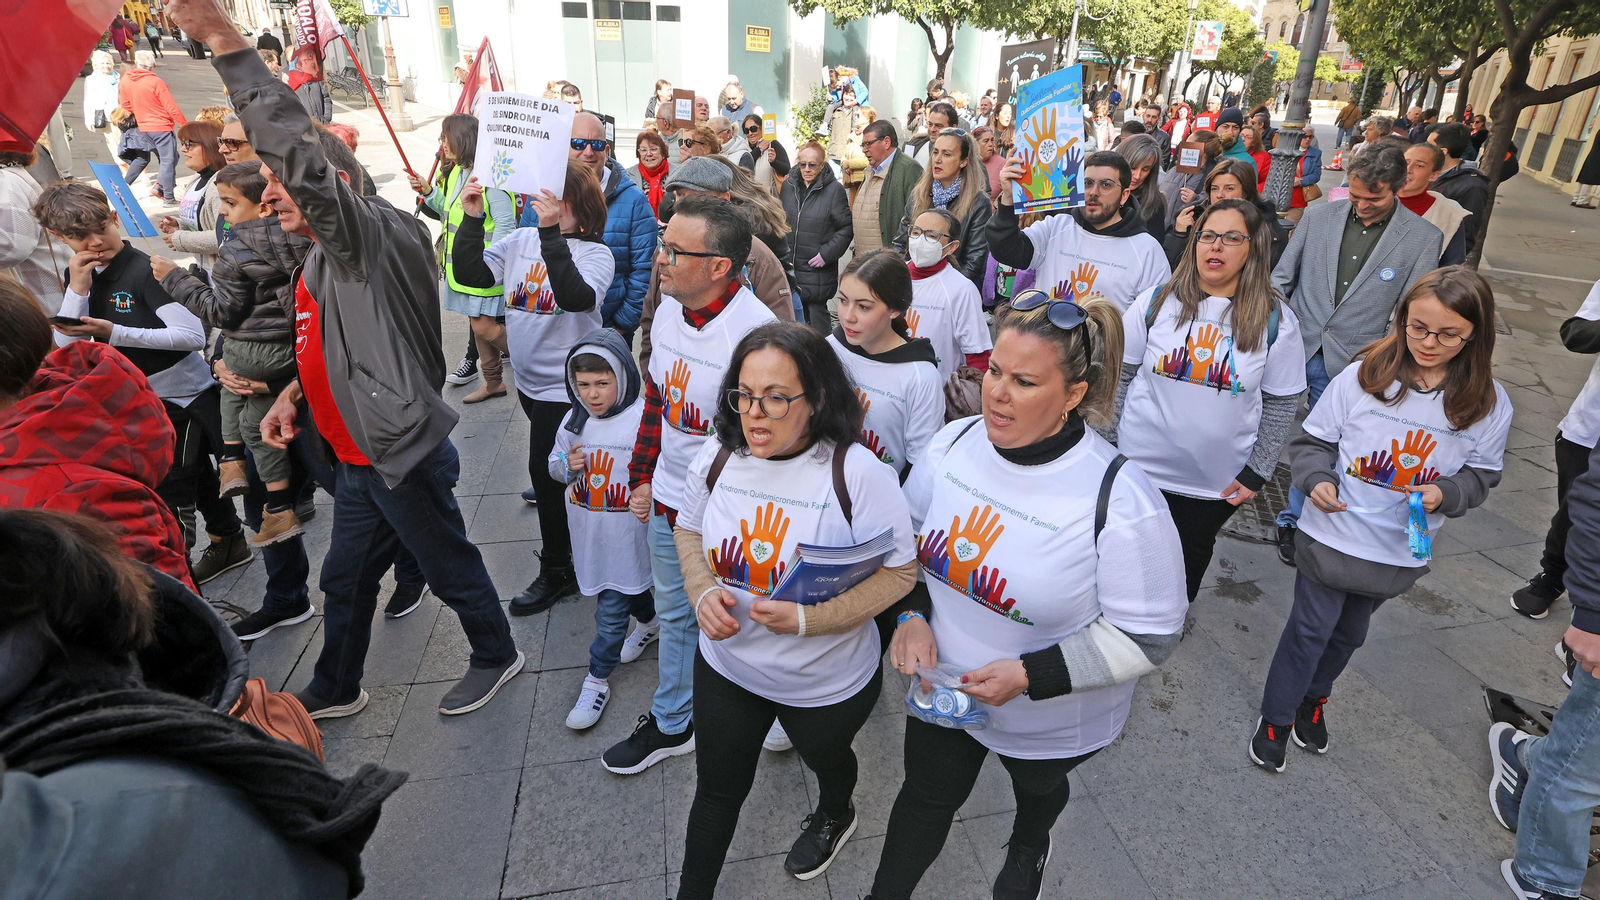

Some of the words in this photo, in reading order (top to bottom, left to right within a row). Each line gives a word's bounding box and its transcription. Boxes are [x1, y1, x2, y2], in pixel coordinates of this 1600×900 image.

[497, 97, 538, 109] NOVIEMBRE
[1401, 418, 1454, 436] Quilomicronemia
[1353, 472, 1406, 491] www.quilomicrone
[750, 490, 808, 508] Quilomicronemia
[971, 488, 1028, 521] Quilomicronemia
[1030, 516, 1059, 532] Familiar
